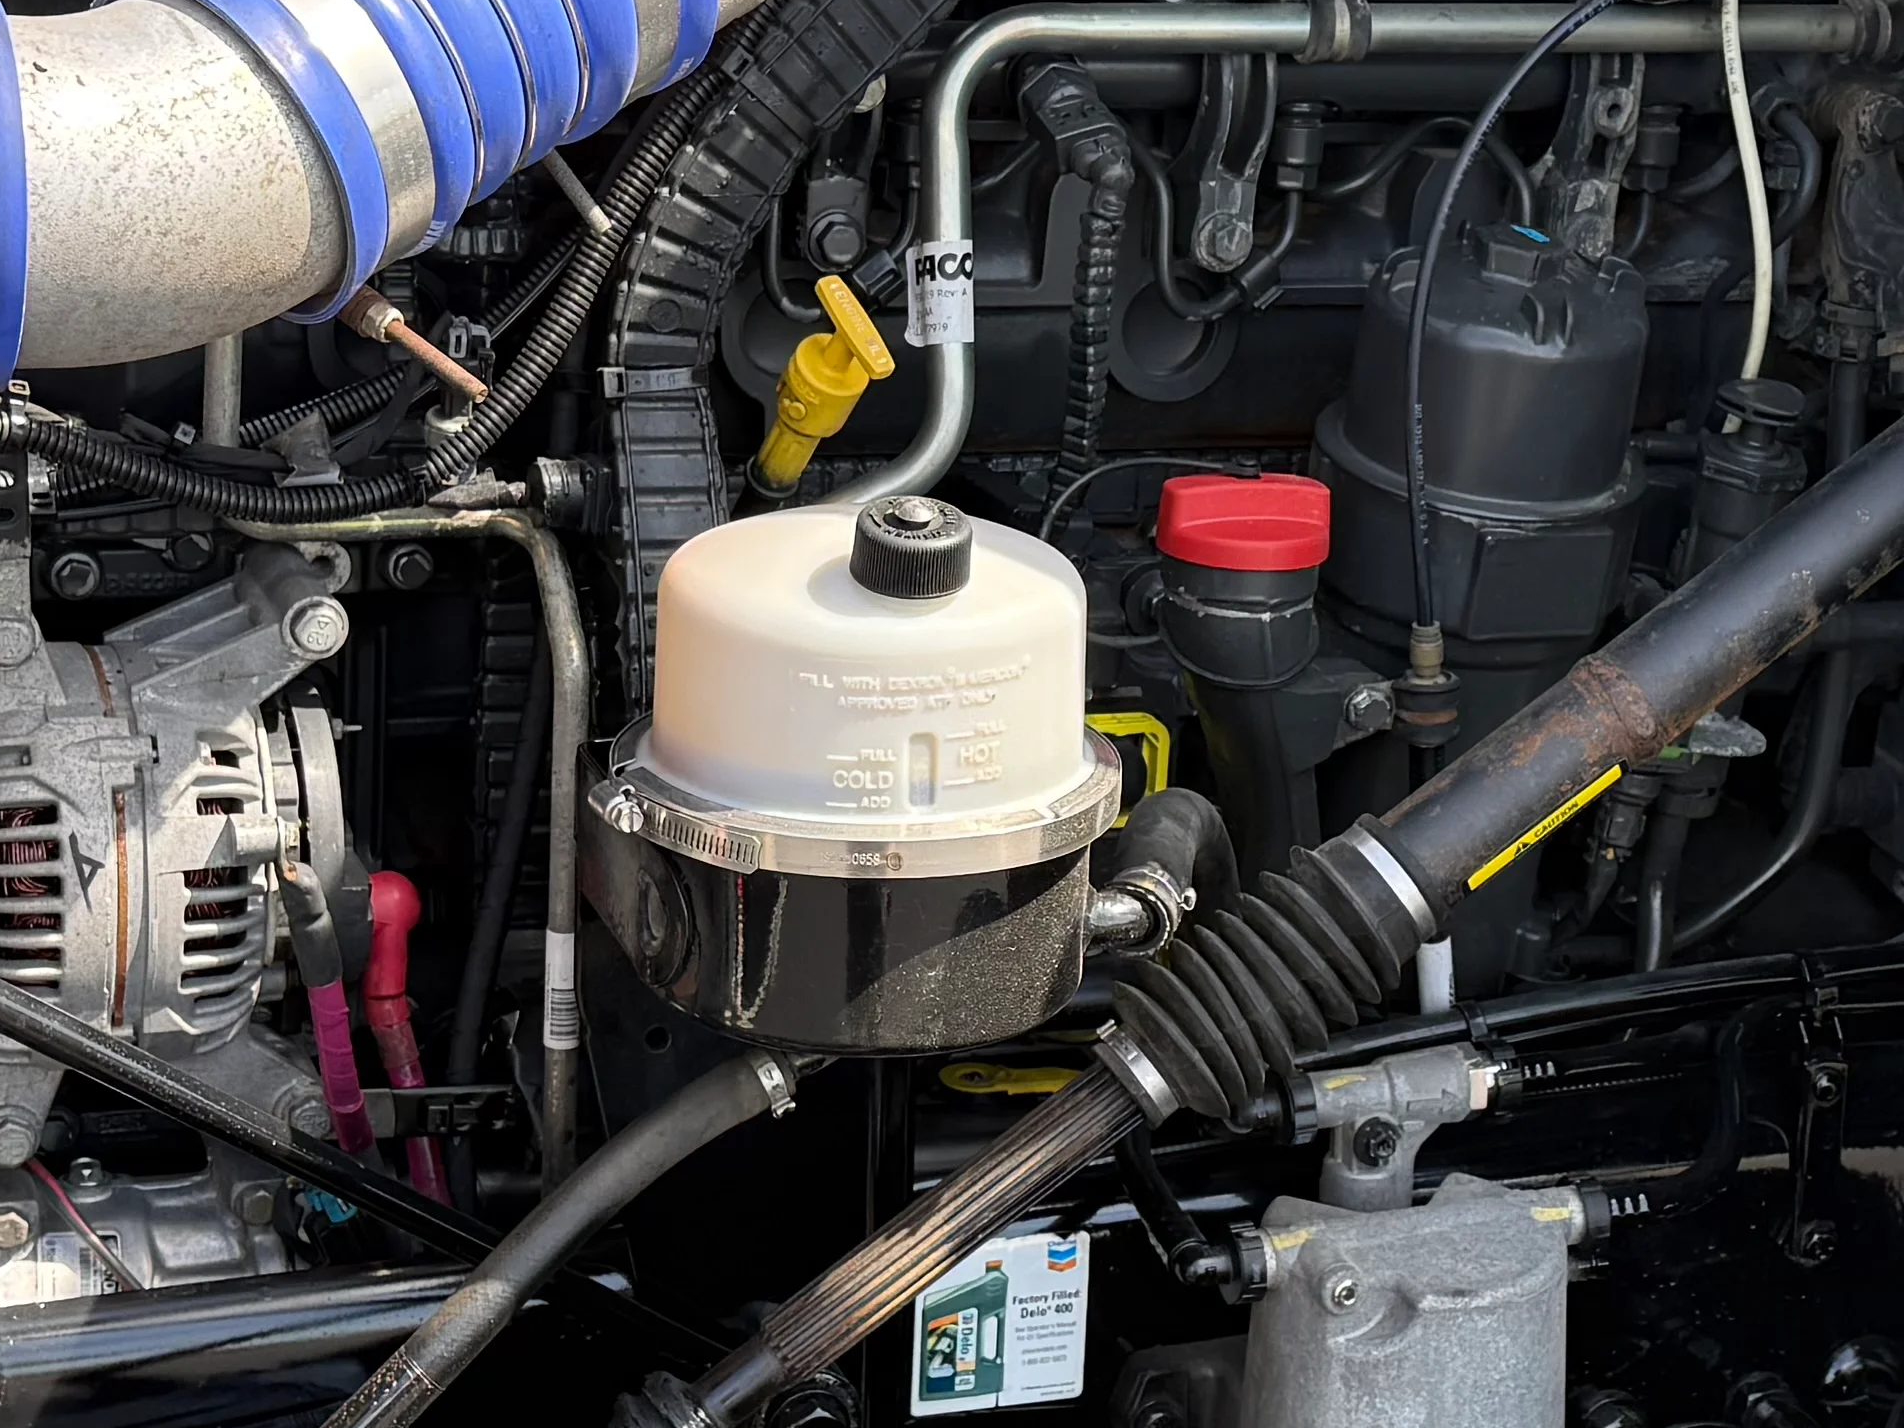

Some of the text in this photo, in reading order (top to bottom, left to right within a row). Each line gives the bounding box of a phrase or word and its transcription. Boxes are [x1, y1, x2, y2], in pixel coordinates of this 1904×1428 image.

[842, 675, 880, 692] WITH
[837, 695, 918, 711] APPROVED
[860, 748, 897, 762] FULL
[960, 740, 1001, 764] HOT
[832, 769, 894, 790] COLD
[860, 795, 892, 809] ADD
[1534, 800, 1580, 839] CAUTION
[1012, 1289, 1082, 1306] Factory Filled:
[1054, 1302, 1074, 1314] 400
[960, 1327, 974, 1356] Delo
